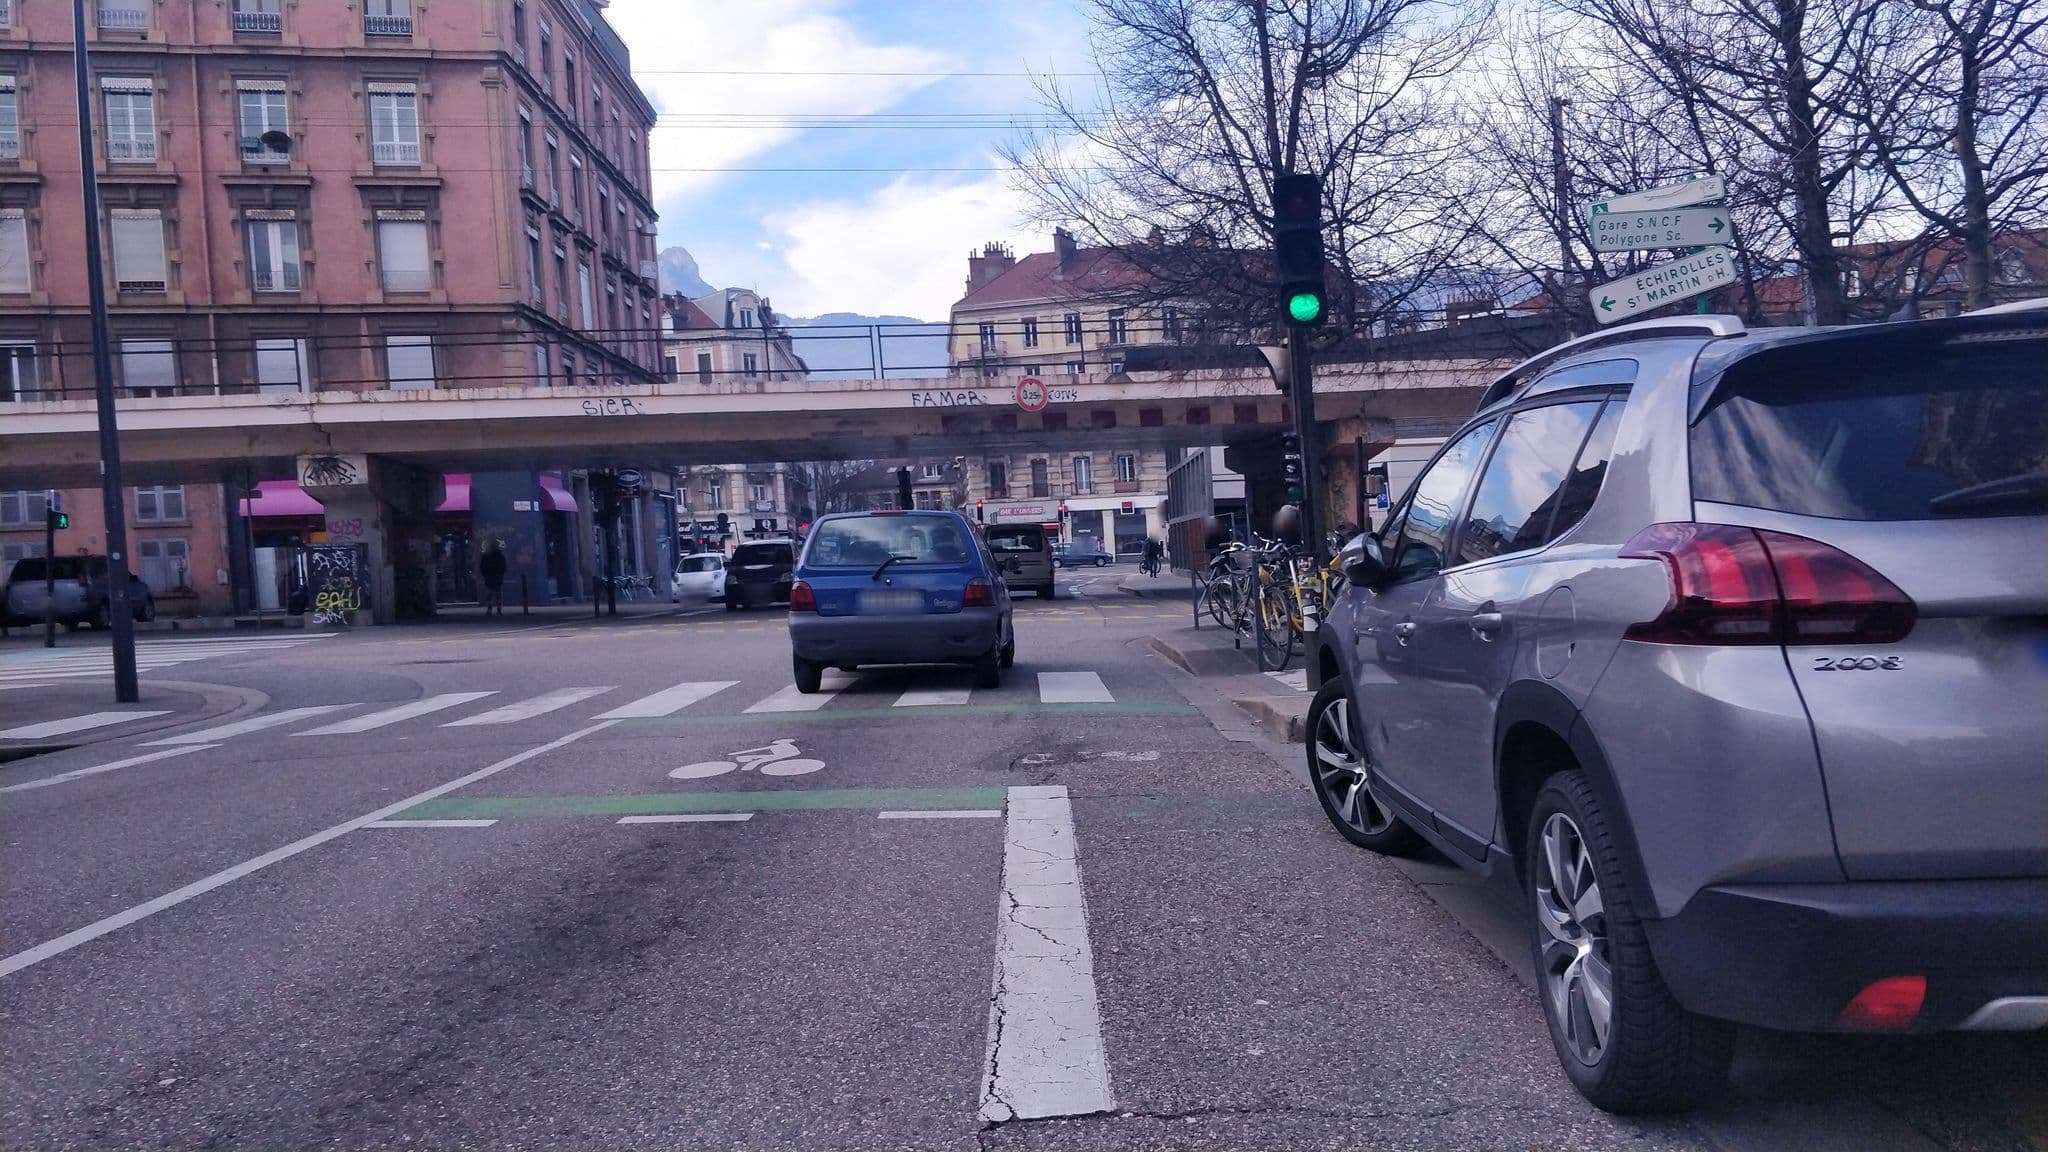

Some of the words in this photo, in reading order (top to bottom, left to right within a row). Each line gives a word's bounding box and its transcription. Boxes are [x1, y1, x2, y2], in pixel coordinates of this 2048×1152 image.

[1599, 220, 1628, 231] Gare
[1600, 232, 1657, 246] Polygone
[1636, 253, 1724, 291] ÉCHIROLLES
[1646, 275, 1701, 303] MARTIN
[1814, 655, 1904, 672] 2008
